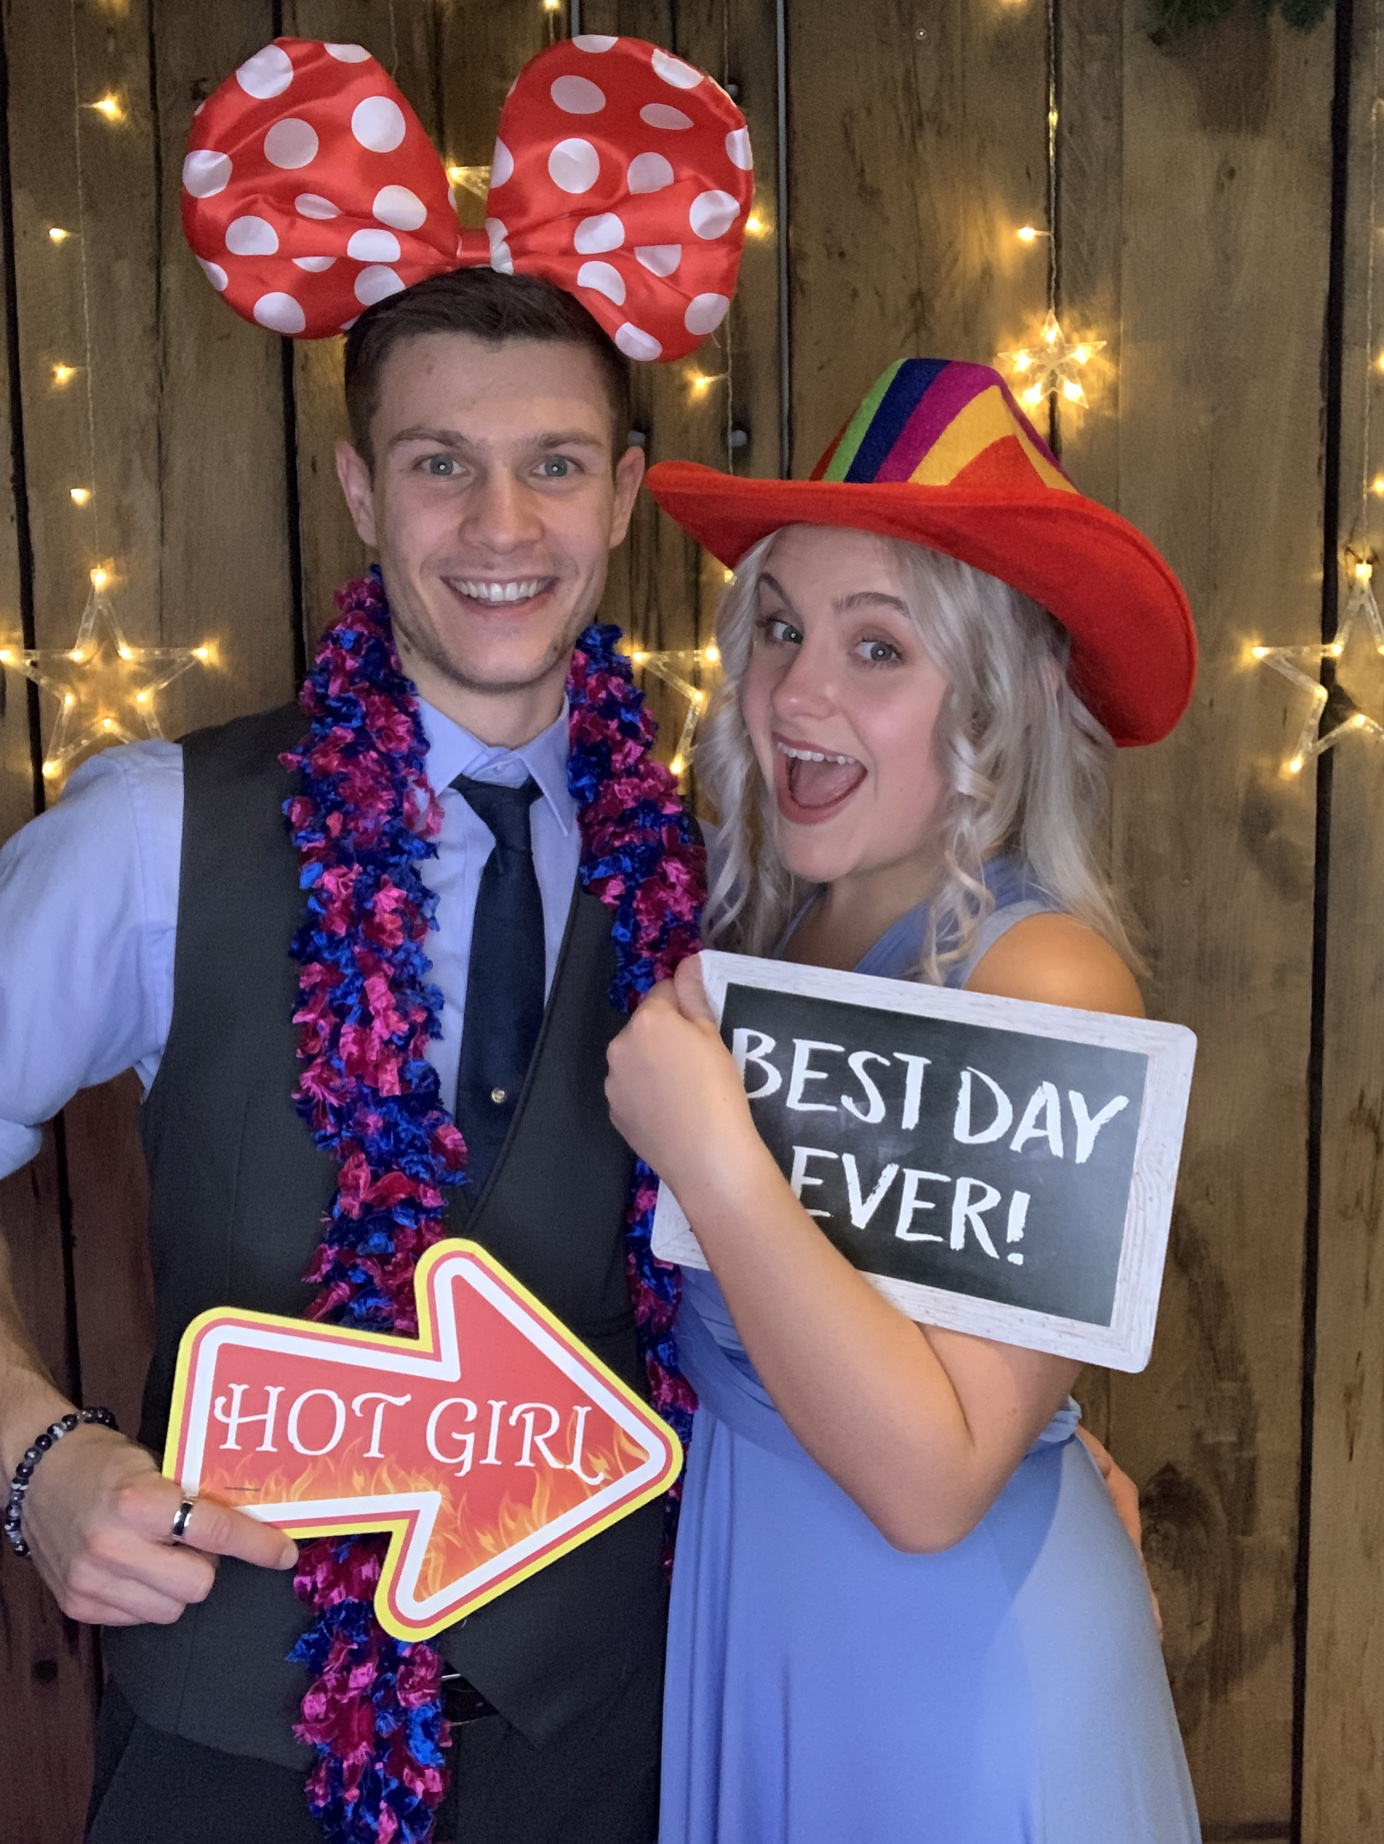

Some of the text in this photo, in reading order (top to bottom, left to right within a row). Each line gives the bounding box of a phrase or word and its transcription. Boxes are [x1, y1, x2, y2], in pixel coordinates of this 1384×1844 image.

[732, 1027, 1130, 1164] BEST DAY
[790, 1145, 1031, 1265] EVER!
[213, 1383, 605, 1486] HOT GIRL
